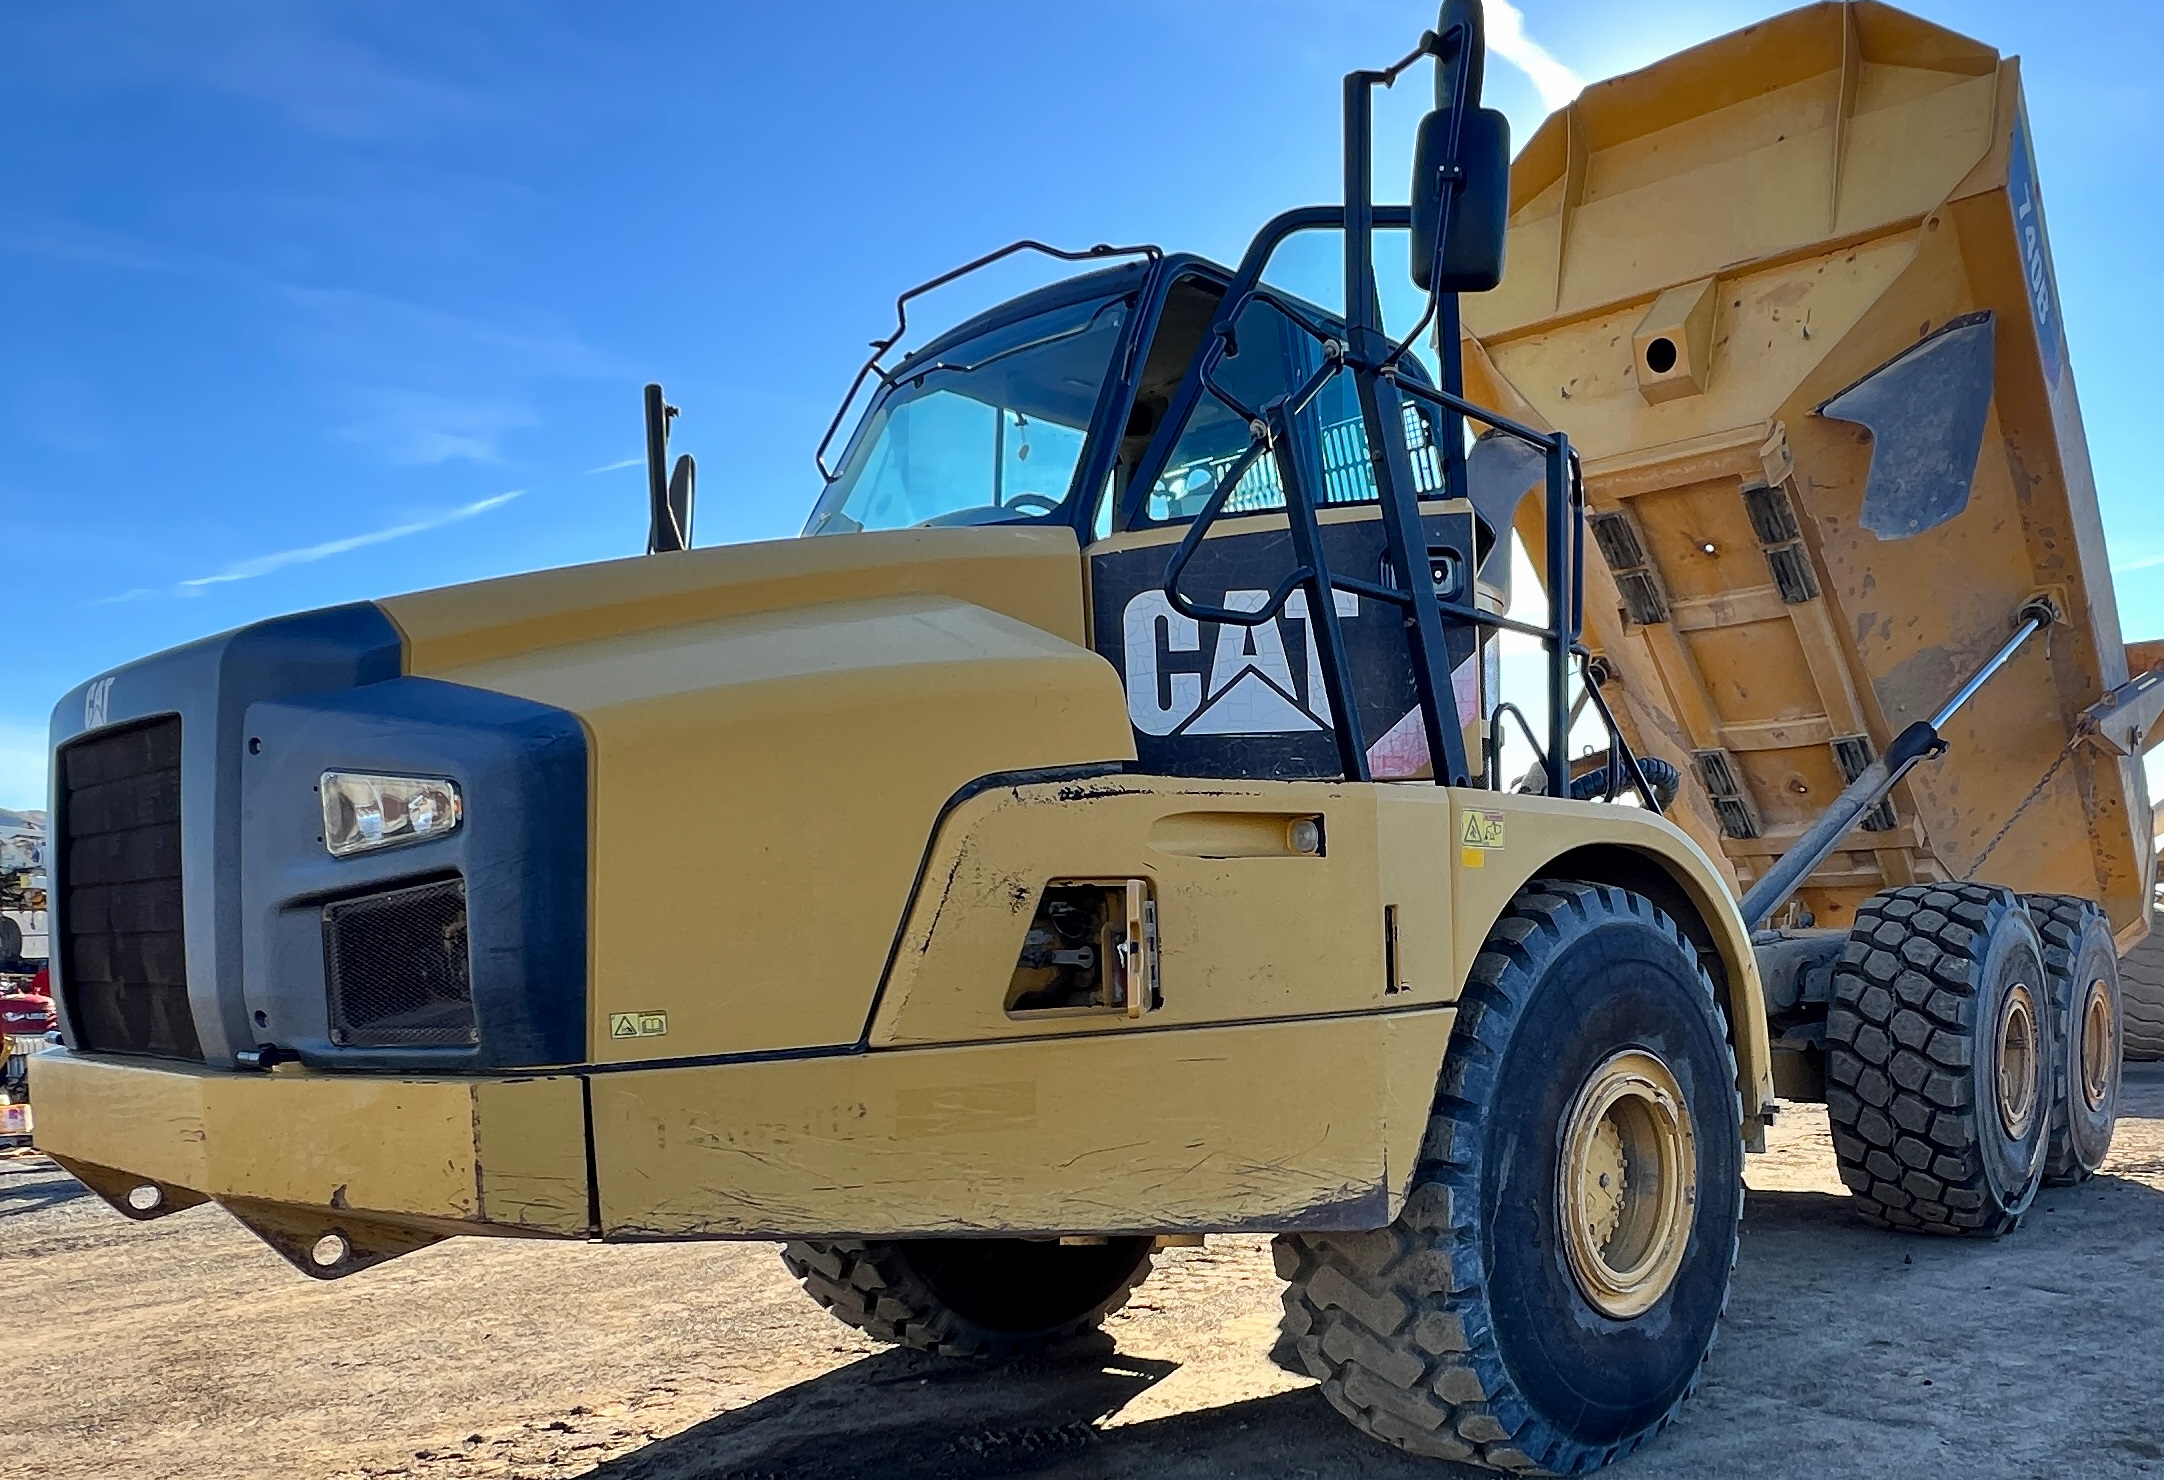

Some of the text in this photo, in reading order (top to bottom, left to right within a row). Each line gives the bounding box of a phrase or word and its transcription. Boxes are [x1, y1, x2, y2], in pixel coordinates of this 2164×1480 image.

[2018, 181, 2050, 326] 740B
[84, 676, 117, 730] CAT
[1122, 588, 1360, 736] CAT
